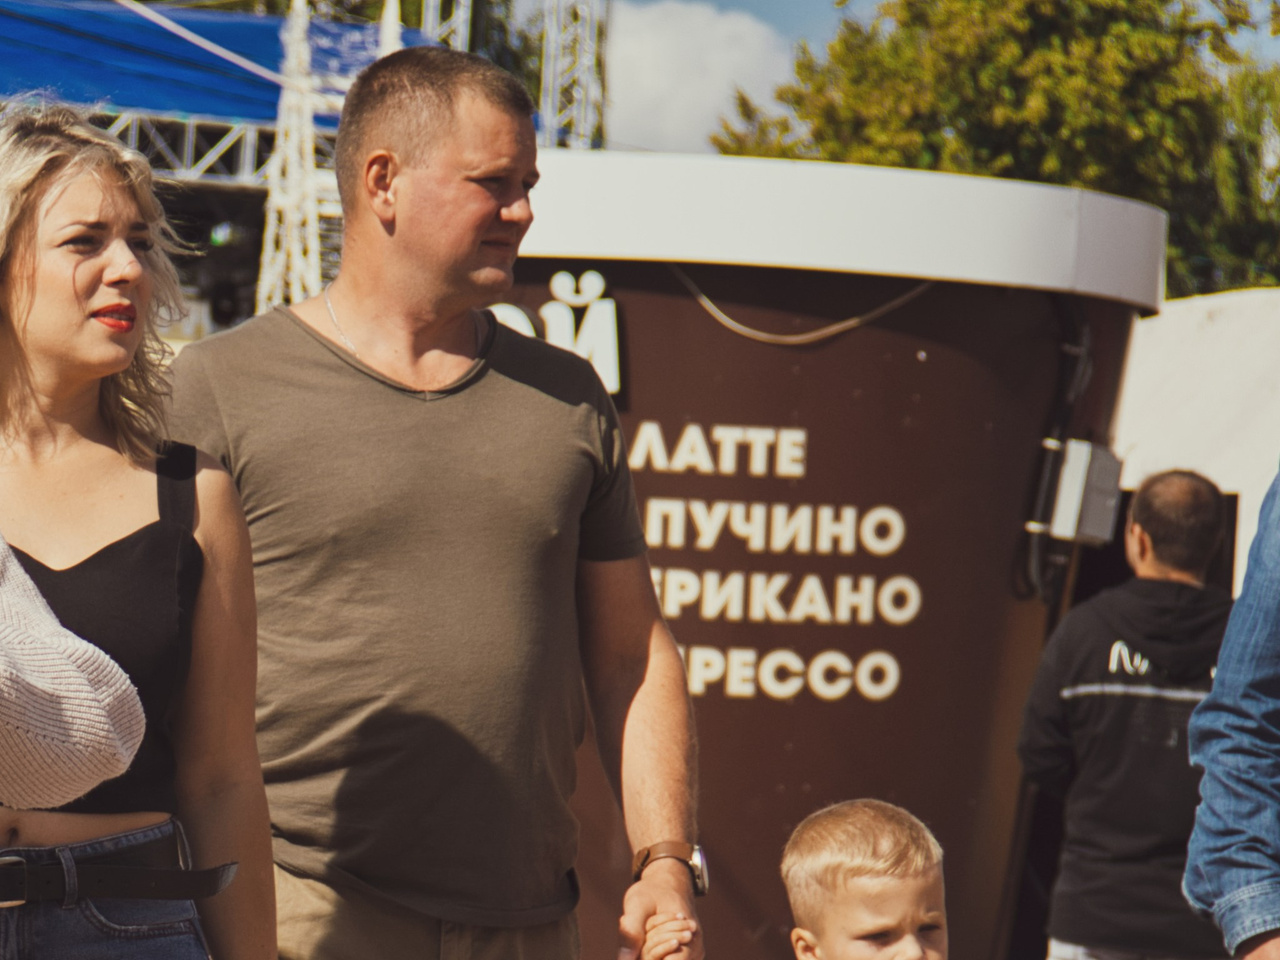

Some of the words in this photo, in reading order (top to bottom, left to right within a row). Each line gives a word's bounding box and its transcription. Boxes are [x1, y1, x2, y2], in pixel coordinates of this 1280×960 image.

[627, 420, 807, 478] ЛАТТЕ
[644, 497, 907, 557] ПУЧИНО
[650, 566, 922, 626] РИКАНО
[677, 644, 902, 701] РЕССО
